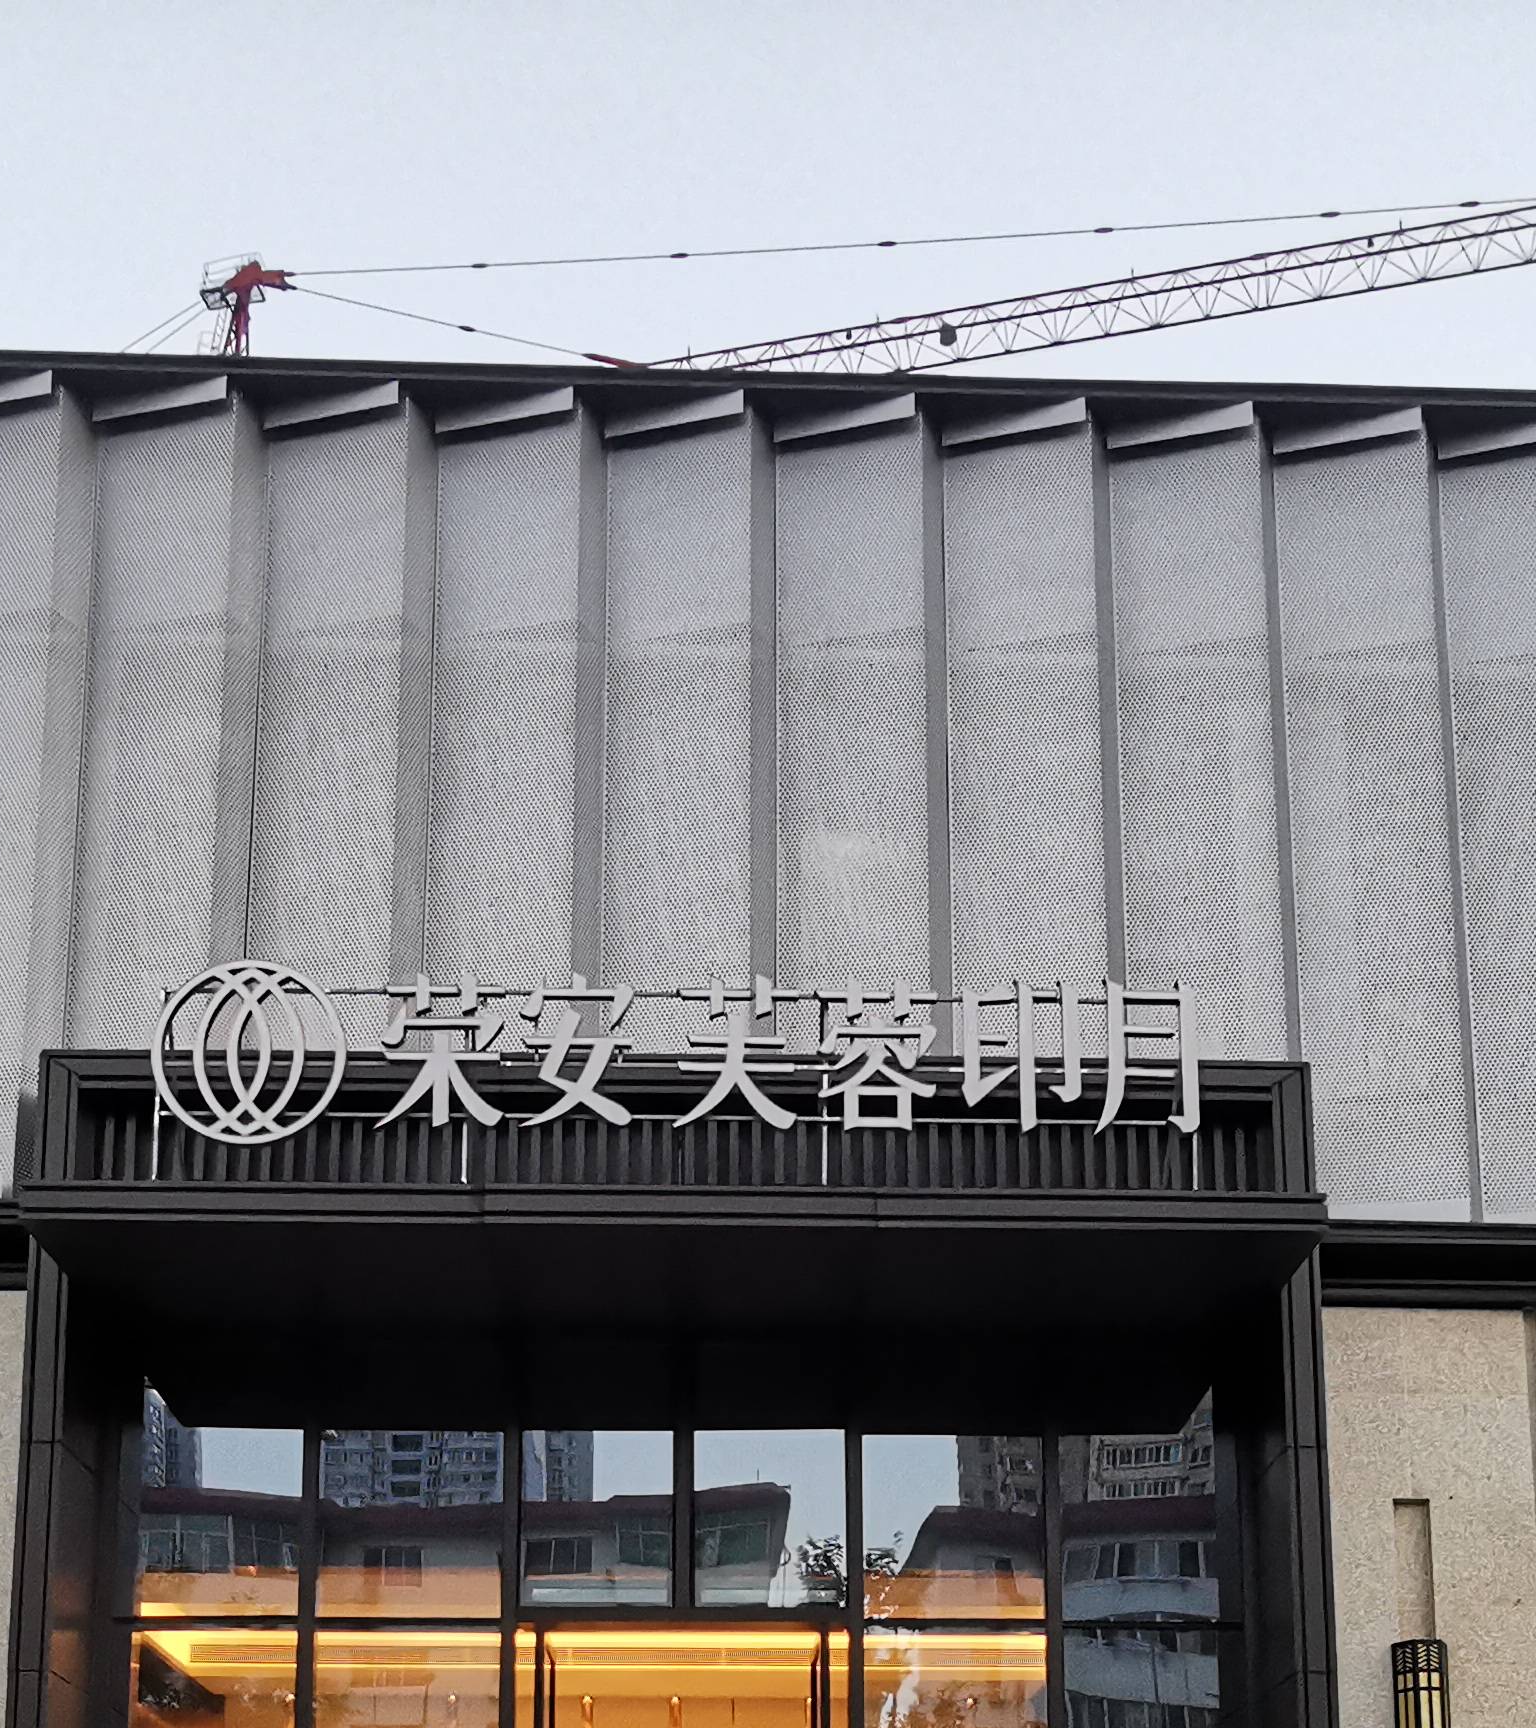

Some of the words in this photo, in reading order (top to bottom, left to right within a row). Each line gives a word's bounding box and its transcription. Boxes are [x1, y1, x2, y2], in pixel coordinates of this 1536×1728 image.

[374, 972, 1201, 1135] 荣安芙蓉印月
